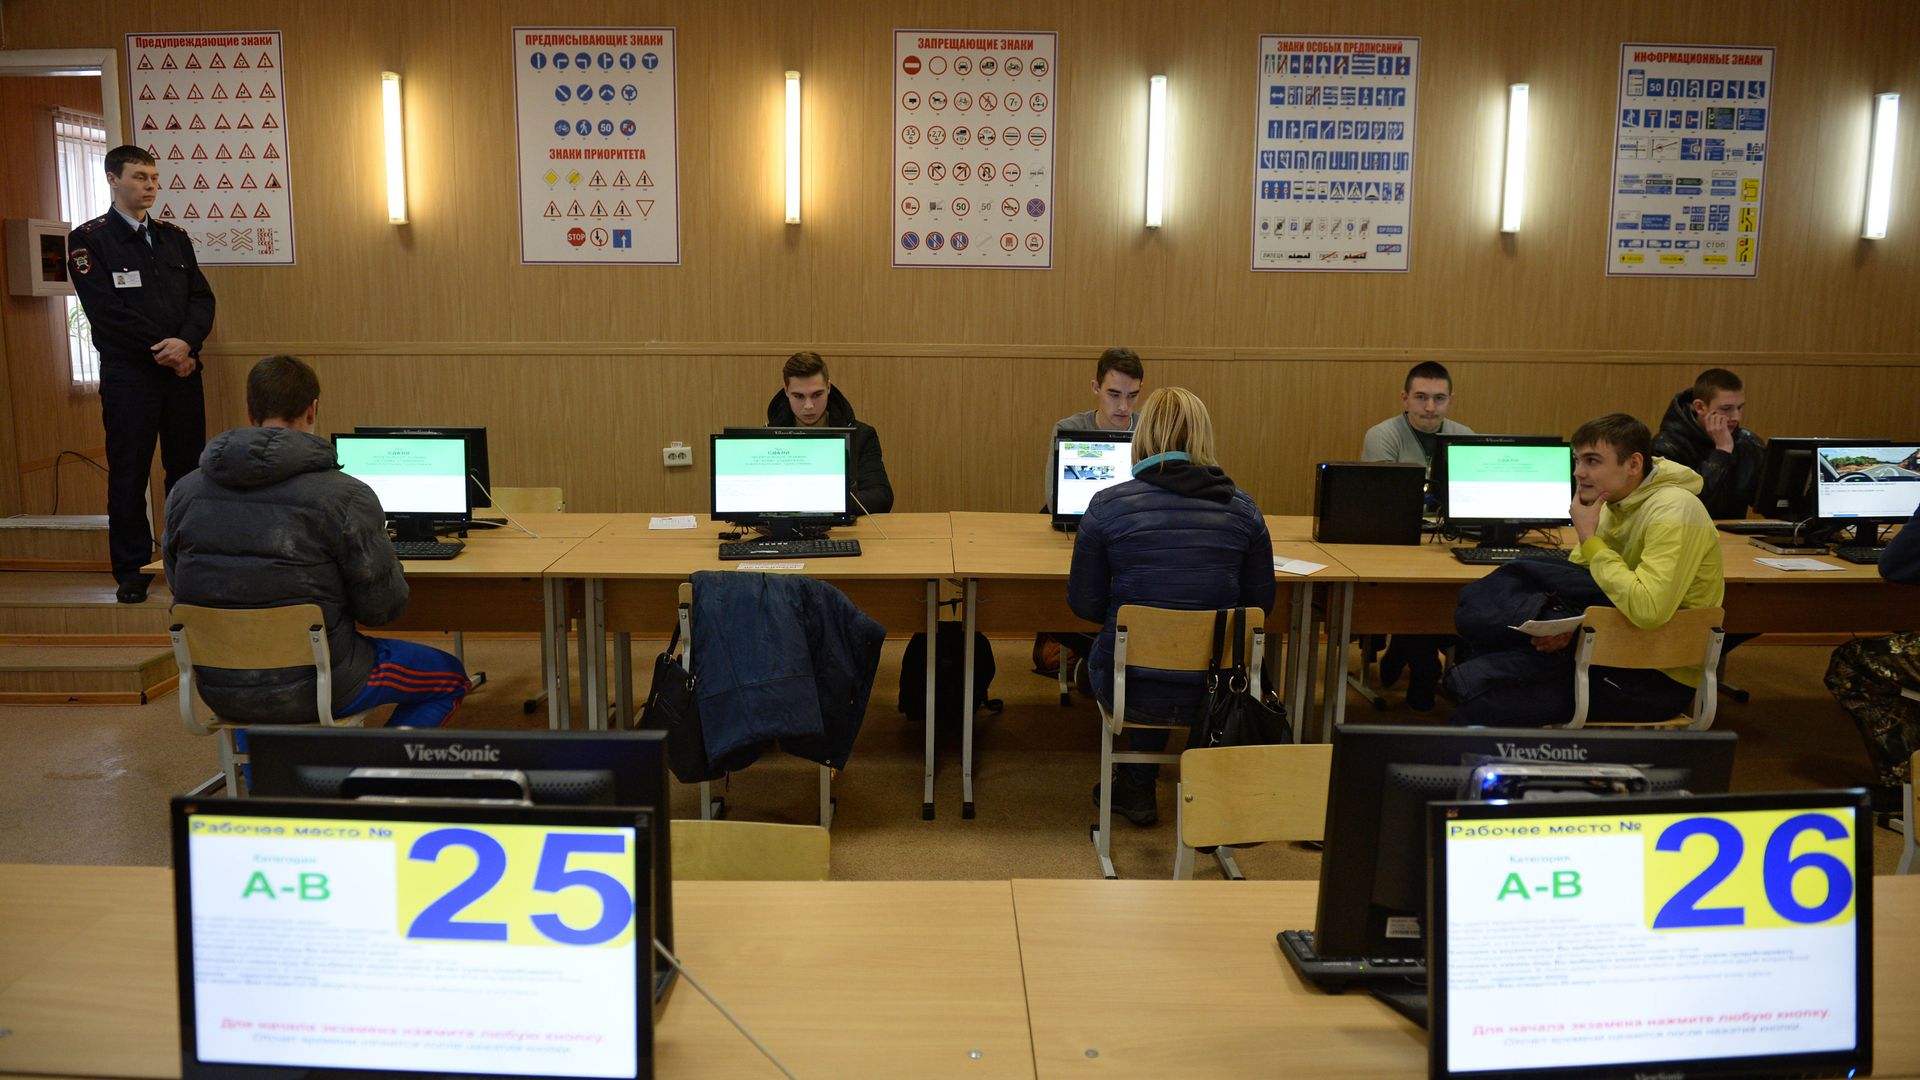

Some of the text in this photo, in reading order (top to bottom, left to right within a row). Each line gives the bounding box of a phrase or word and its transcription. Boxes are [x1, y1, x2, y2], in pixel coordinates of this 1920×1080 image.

[135, 35, 273, 48] Предупреждающие знаки
[525, 34, 663, 47] ПРЕДПИСЫВАЮЩИЕ ЗНАКИ
[917, 37, 1034, 50] ЗАПРЕЩАЮЩИЕ ЗНАКИ
[1277, 41, 1403, 54] ЗНАКИ ОСОБЫХ ПРЕДПИСАНИЙ
[1634, 52, 1763, 65] ИНФОРМАЦИОННЫЕ ЗНАКИ
[1649, 84, 1661, 92] 50
[600, 123, 611, 132] 50
[549, 148, 646, 160] ЗНАКИ ПРИОРИТЕТА
[956, 202, 966, 211] 50
[568, 233, 586, 241] STOP
[404, 742, 501, 763] ViewSonic
[1496, 742, 1589, 761] ViewSonic
[191, 820, 285, 835] Рабочее
[294, 826, 361, 838] место
[1450, 820, 1642, 837] Рабочее место №
[1652, 811, 1854, 929] 26
[405, 827, 635, 947] 25
